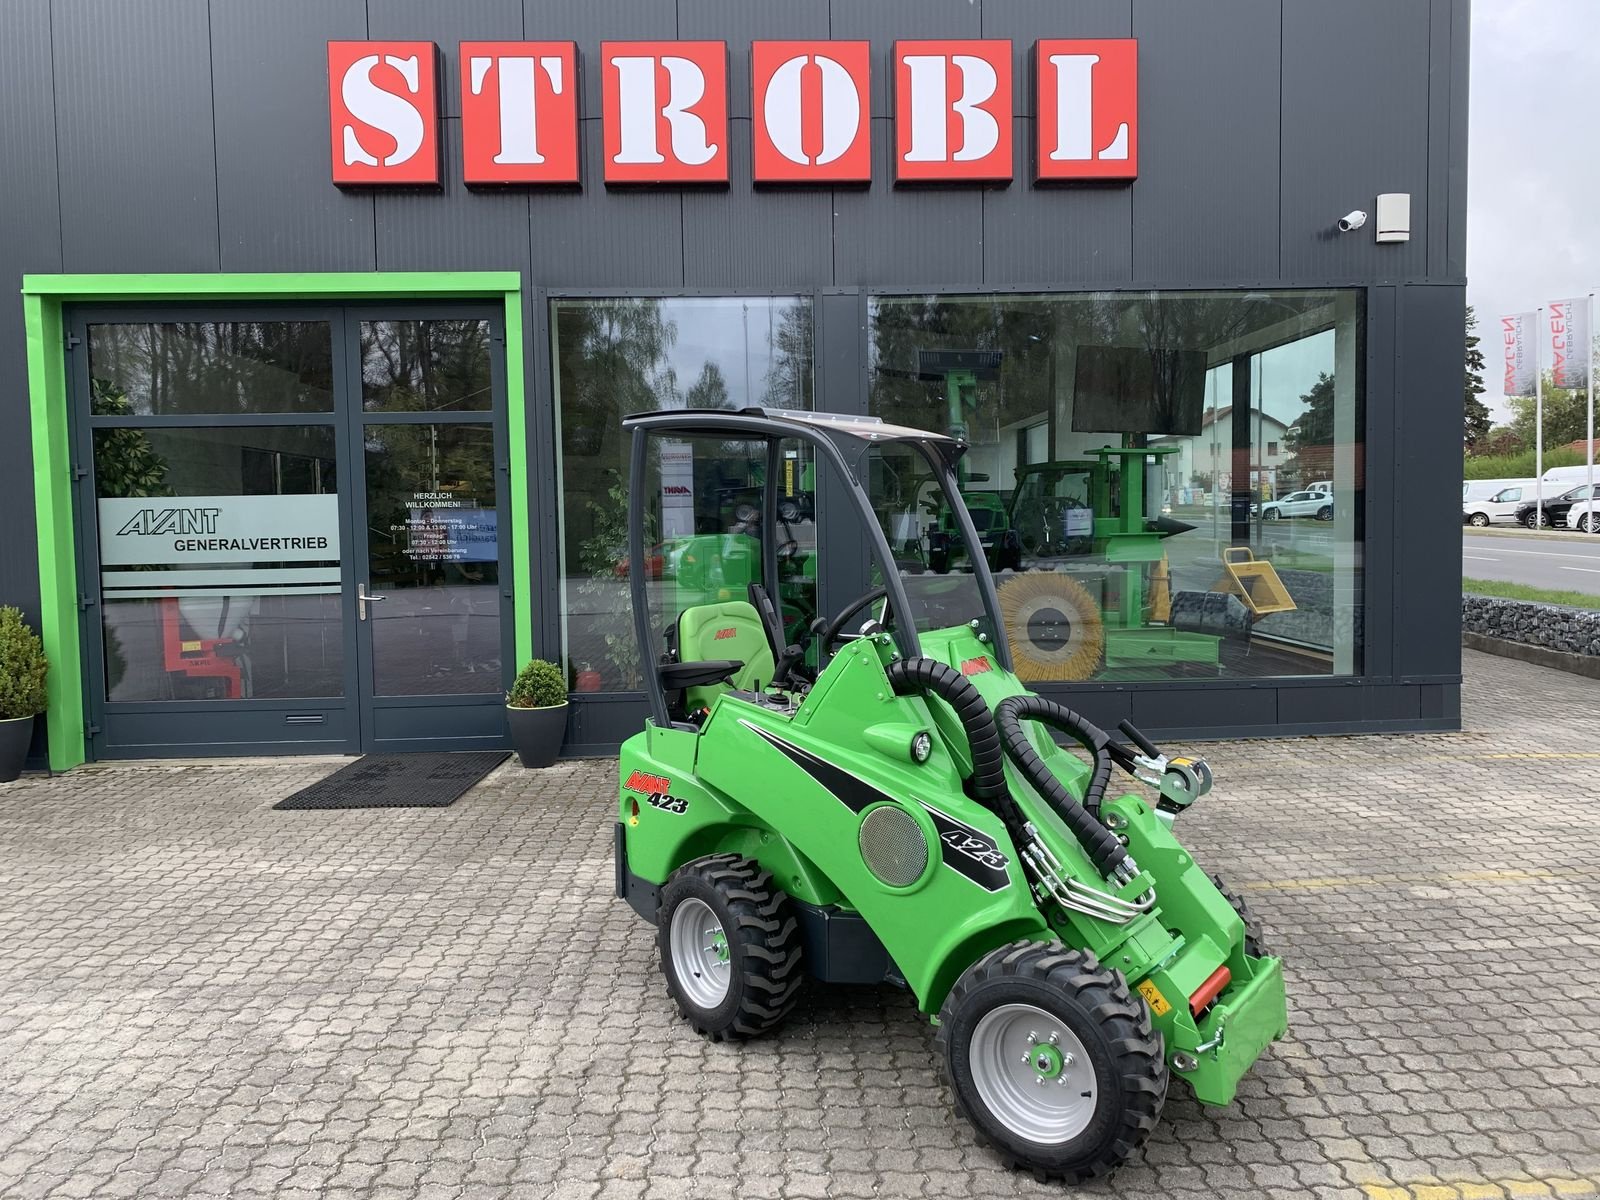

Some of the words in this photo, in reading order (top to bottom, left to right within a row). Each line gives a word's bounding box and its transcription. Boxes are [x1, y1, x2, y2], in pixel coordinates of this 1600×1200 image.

[341, 53, 1129, 168] STROBL
[413, 492, 453, 500] HERZLICH
[116, 508, 219, 536] AVANT
[174, 537, 328, 552] GENERALVERTRIEB
[622, 769, 671, 797] AVANT
[646, 792, 690, 816] 423
[940, 829, 1010, 870] 423
